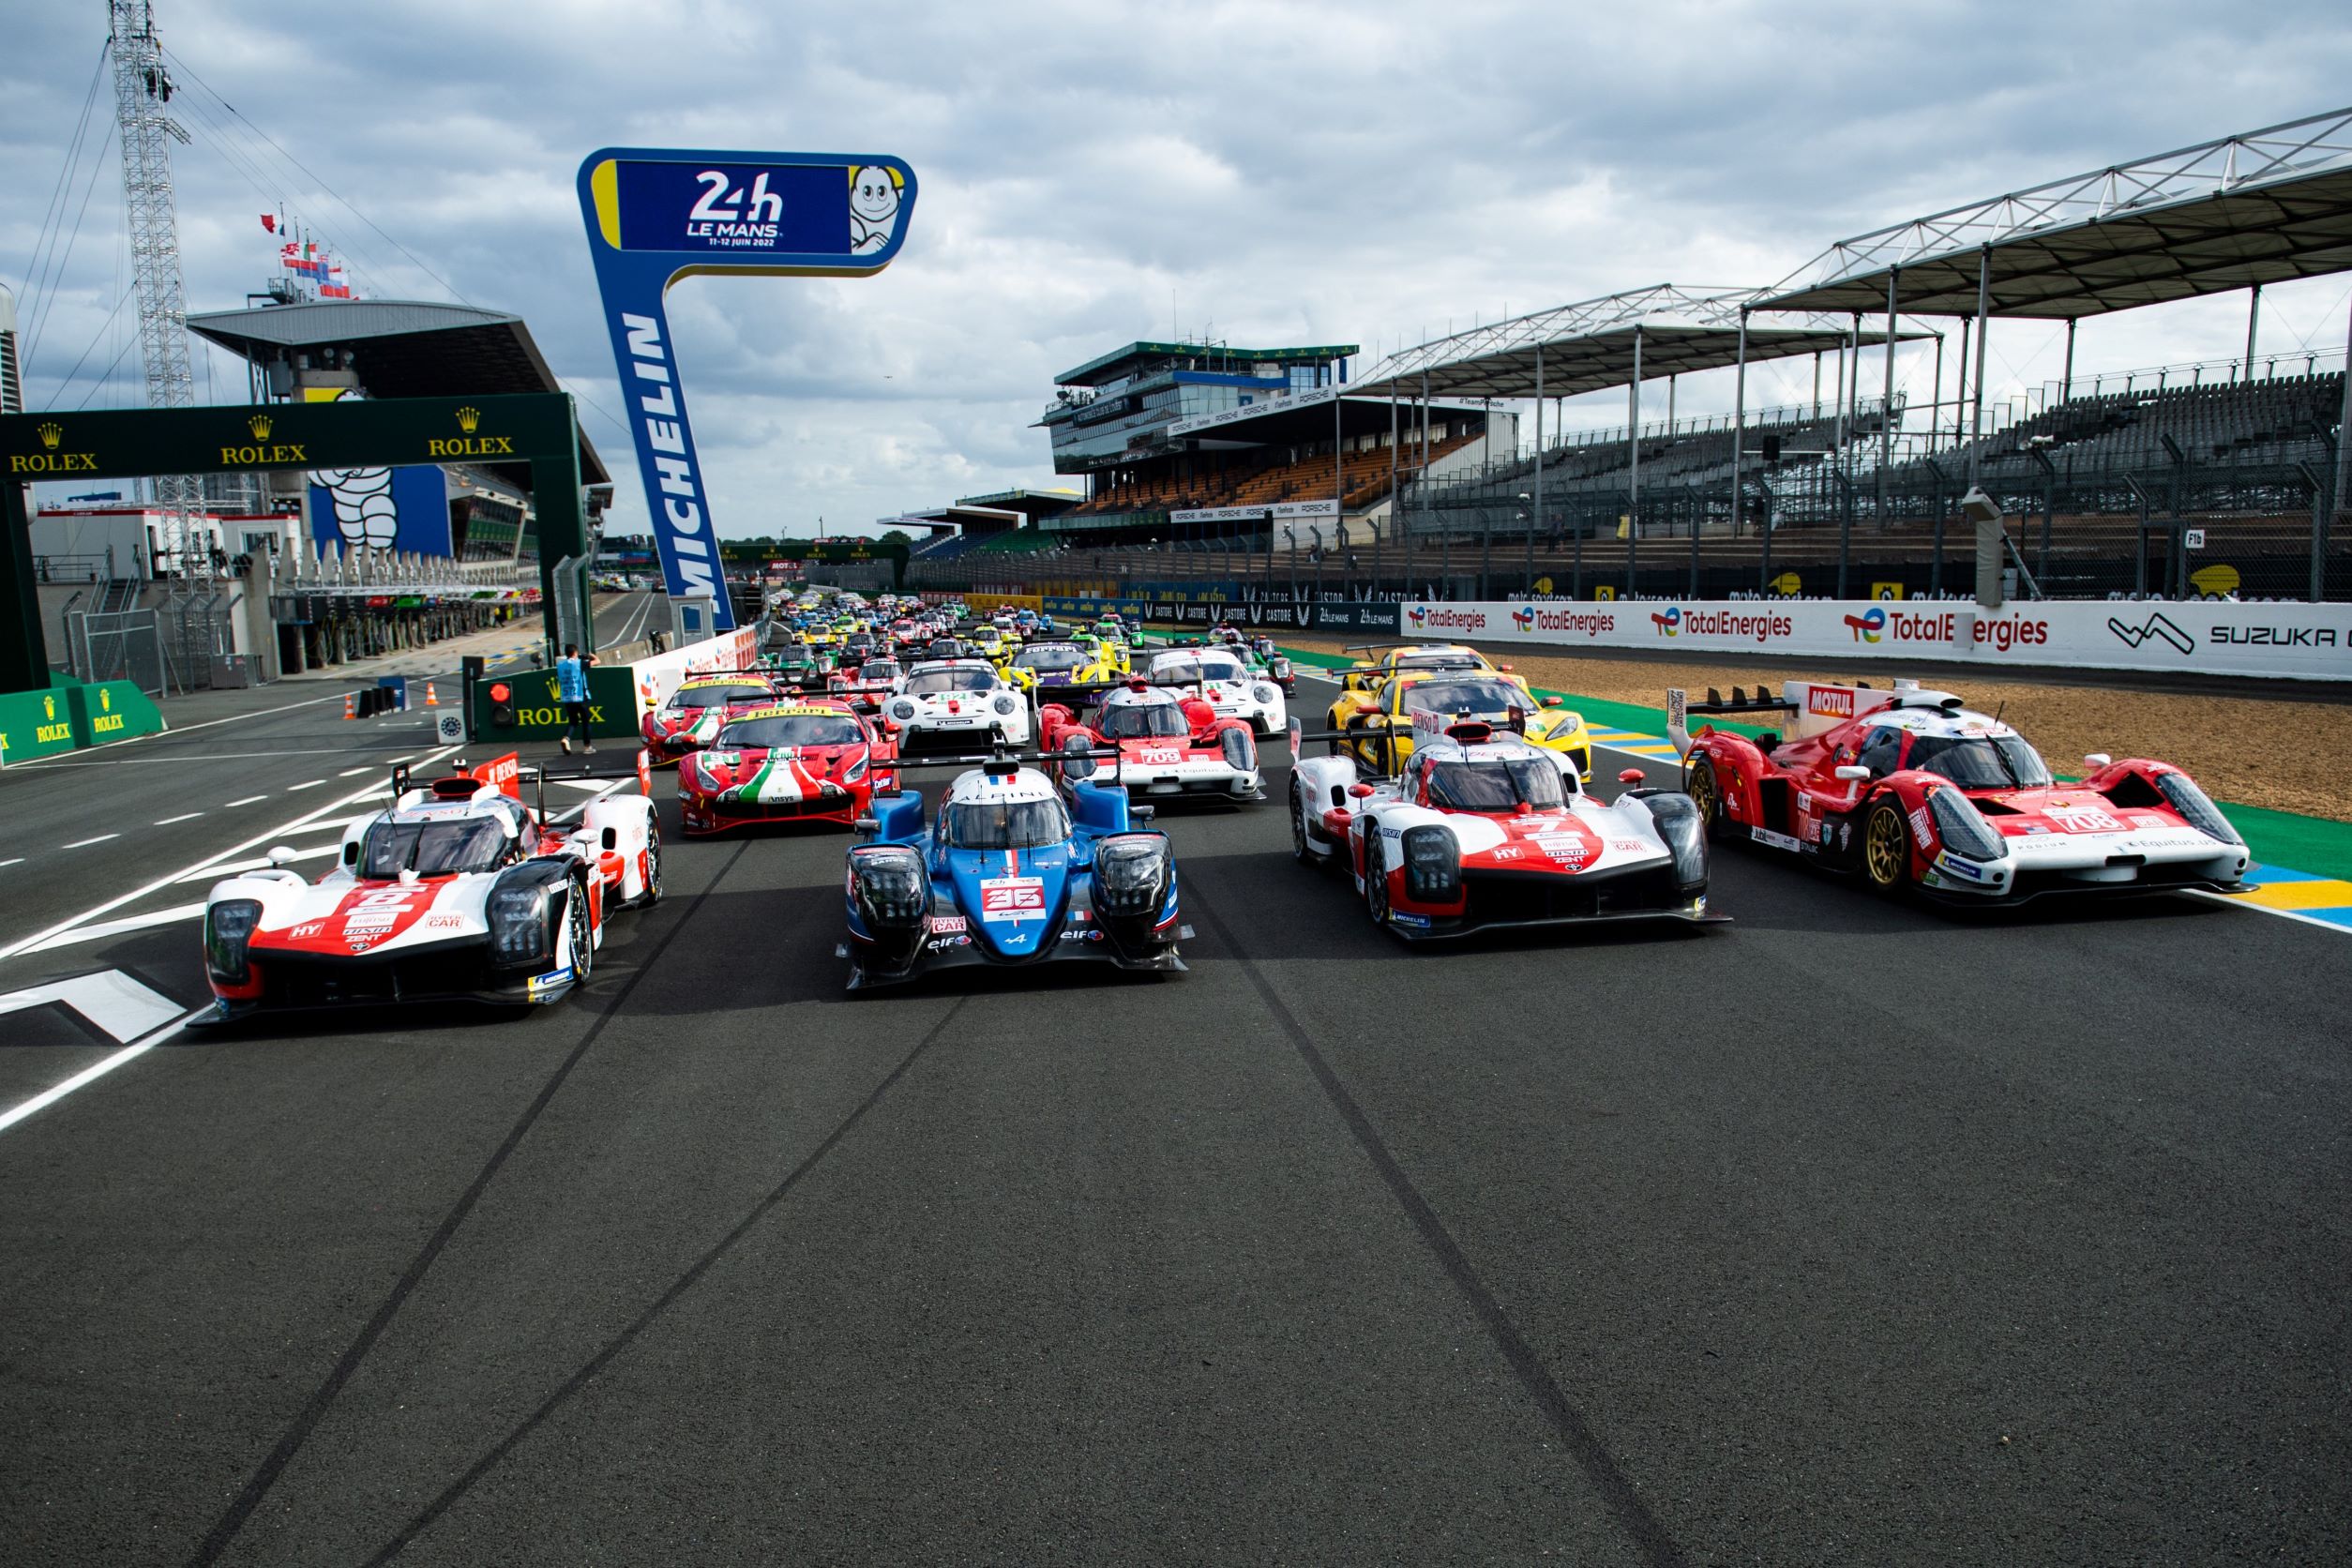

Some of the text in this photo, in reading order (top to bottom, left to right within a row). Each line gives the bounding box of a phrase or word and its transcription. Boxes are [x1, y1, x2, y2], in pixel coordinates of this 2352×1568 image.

[689, 171, 783, 221] 24h
[686, 223, 778, 237] LE MANS
[709, 237, 775, 247] 11-12 JUIN 2022
[1299, 389, 1330, 403] PORSCHE
[1244, 404, 1268, 415] PORSCHE
[1215, 411, 1238, 422] PORSCHE
[429, 437, 514, 456] ROLEX
[220, 445, 308, 464] ROLEX
[10, 454, 98, 472] ROLEX
[622, 312, 720, 614] MICHELIN
[1301, 504, 1331, 512] PORSCHE
[2188, 533, 2202, 545] F1b
[1155, 606, 1172, 617] CASTORE
[1187, 608, 1206, 619] CASTORE
[1224, 609, 1246, 620] CASTORE
[1267, 610, 1291, 622] CASTORE
[1371, 615, 1380, 624] LE
[1380, 615, 1394, 625] MANS
[1426, 609, 1486, 633] TotalEnergies
[1536, 610, 1615, 637] TotalEnergies
[1683, 610, 1792, 642] TotalEnergies
[1890, 612, 2049, 652] TotalEergies
[2210, 626, 2336, 647] SUZUKA
[1025, 645, 1078, 654] Ferrari
[1811, 690, 1852, 714] MOTUL
[518, 706, 605, 726] ROLX
[754, 707, 826, 718] Ferrari
[94, 715, 124, 732] ROLEX
[1413, 711, 1432, 732] DENSO
[37, 723, 70, 743] ROLEX
[1145, 752, 1180, 762] 709
[496, 758, 517, 783] DENSO
[1521, 822, 1560, 832] 7
[2061, 813, 2119, 831] 708
[1497, 848, 1519, 860] HY
[357, 892, 413, 907] 8
[985, 887, 1043, 910] 36
[429, 920, 460, 928] CAR
[934, 923, 965, 932] CAR
[291, 925, 321, 938] HY
[345, 934, 383, 942] ZENT
[1060, 930, 1089, 940] elf
[927, 937, 956, 949] elf
